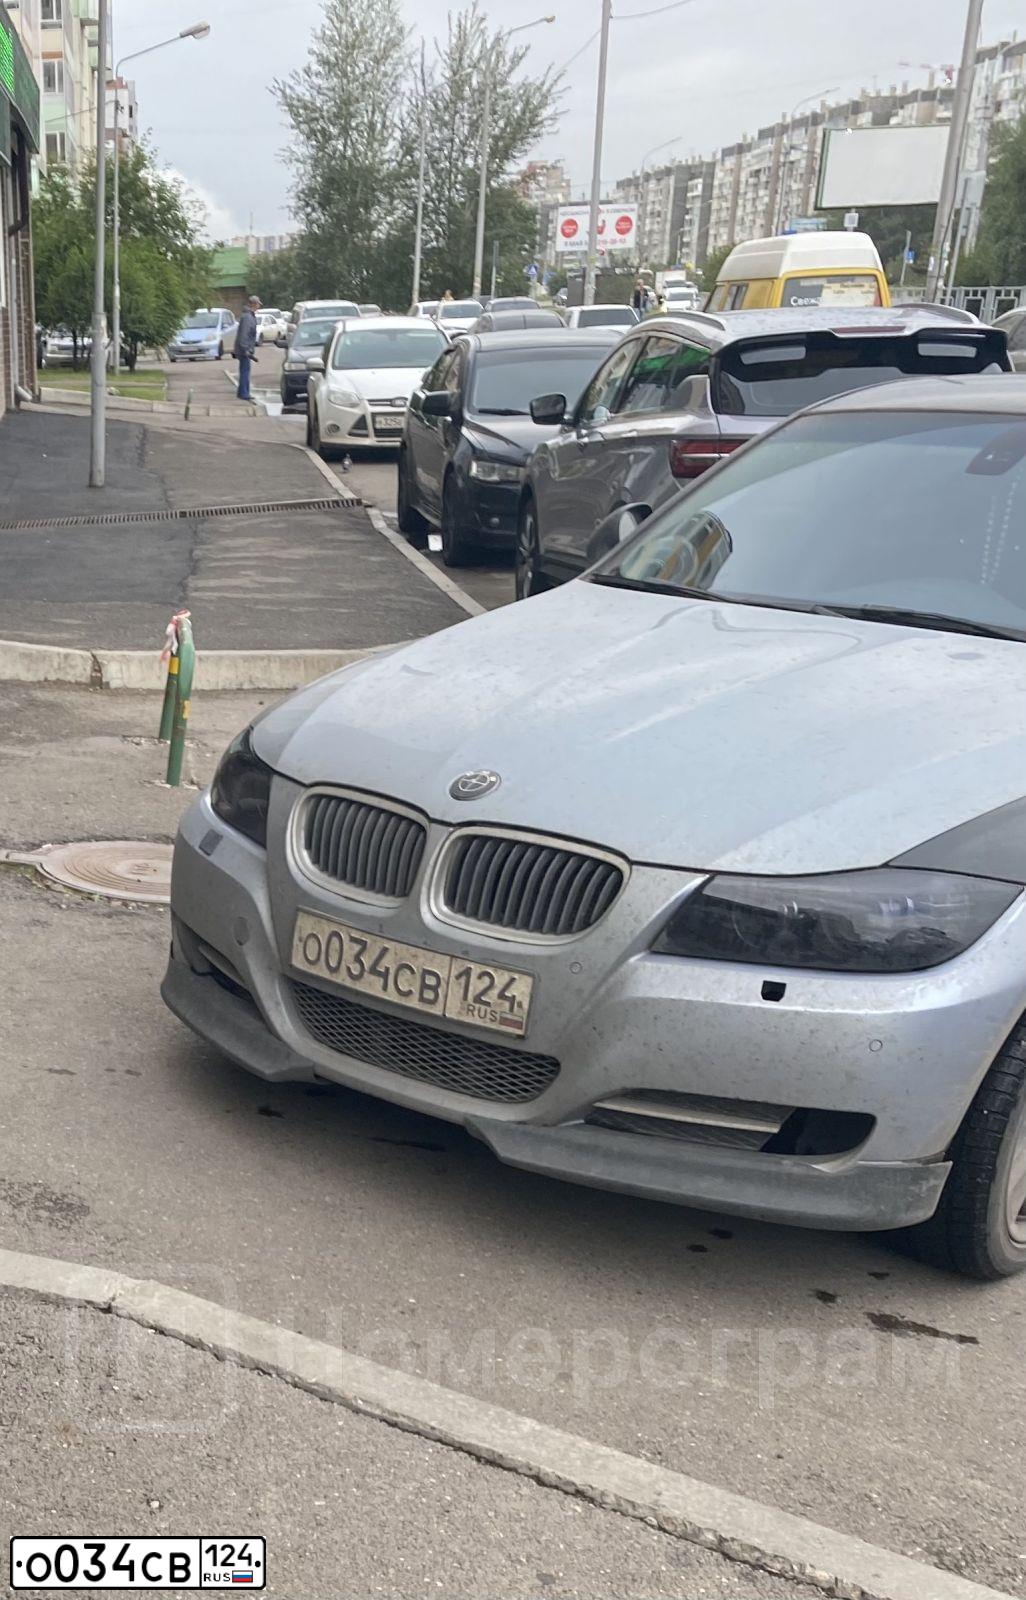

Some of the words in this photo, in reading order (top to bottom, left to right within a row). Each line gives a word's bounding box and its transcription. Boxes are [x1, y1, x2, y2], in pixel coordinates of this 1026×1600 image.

[302, 930, 443, 1005] О034СВ
[454, 965, 517, 1013] 124
[466, 1004, 498, 1023] RUS
